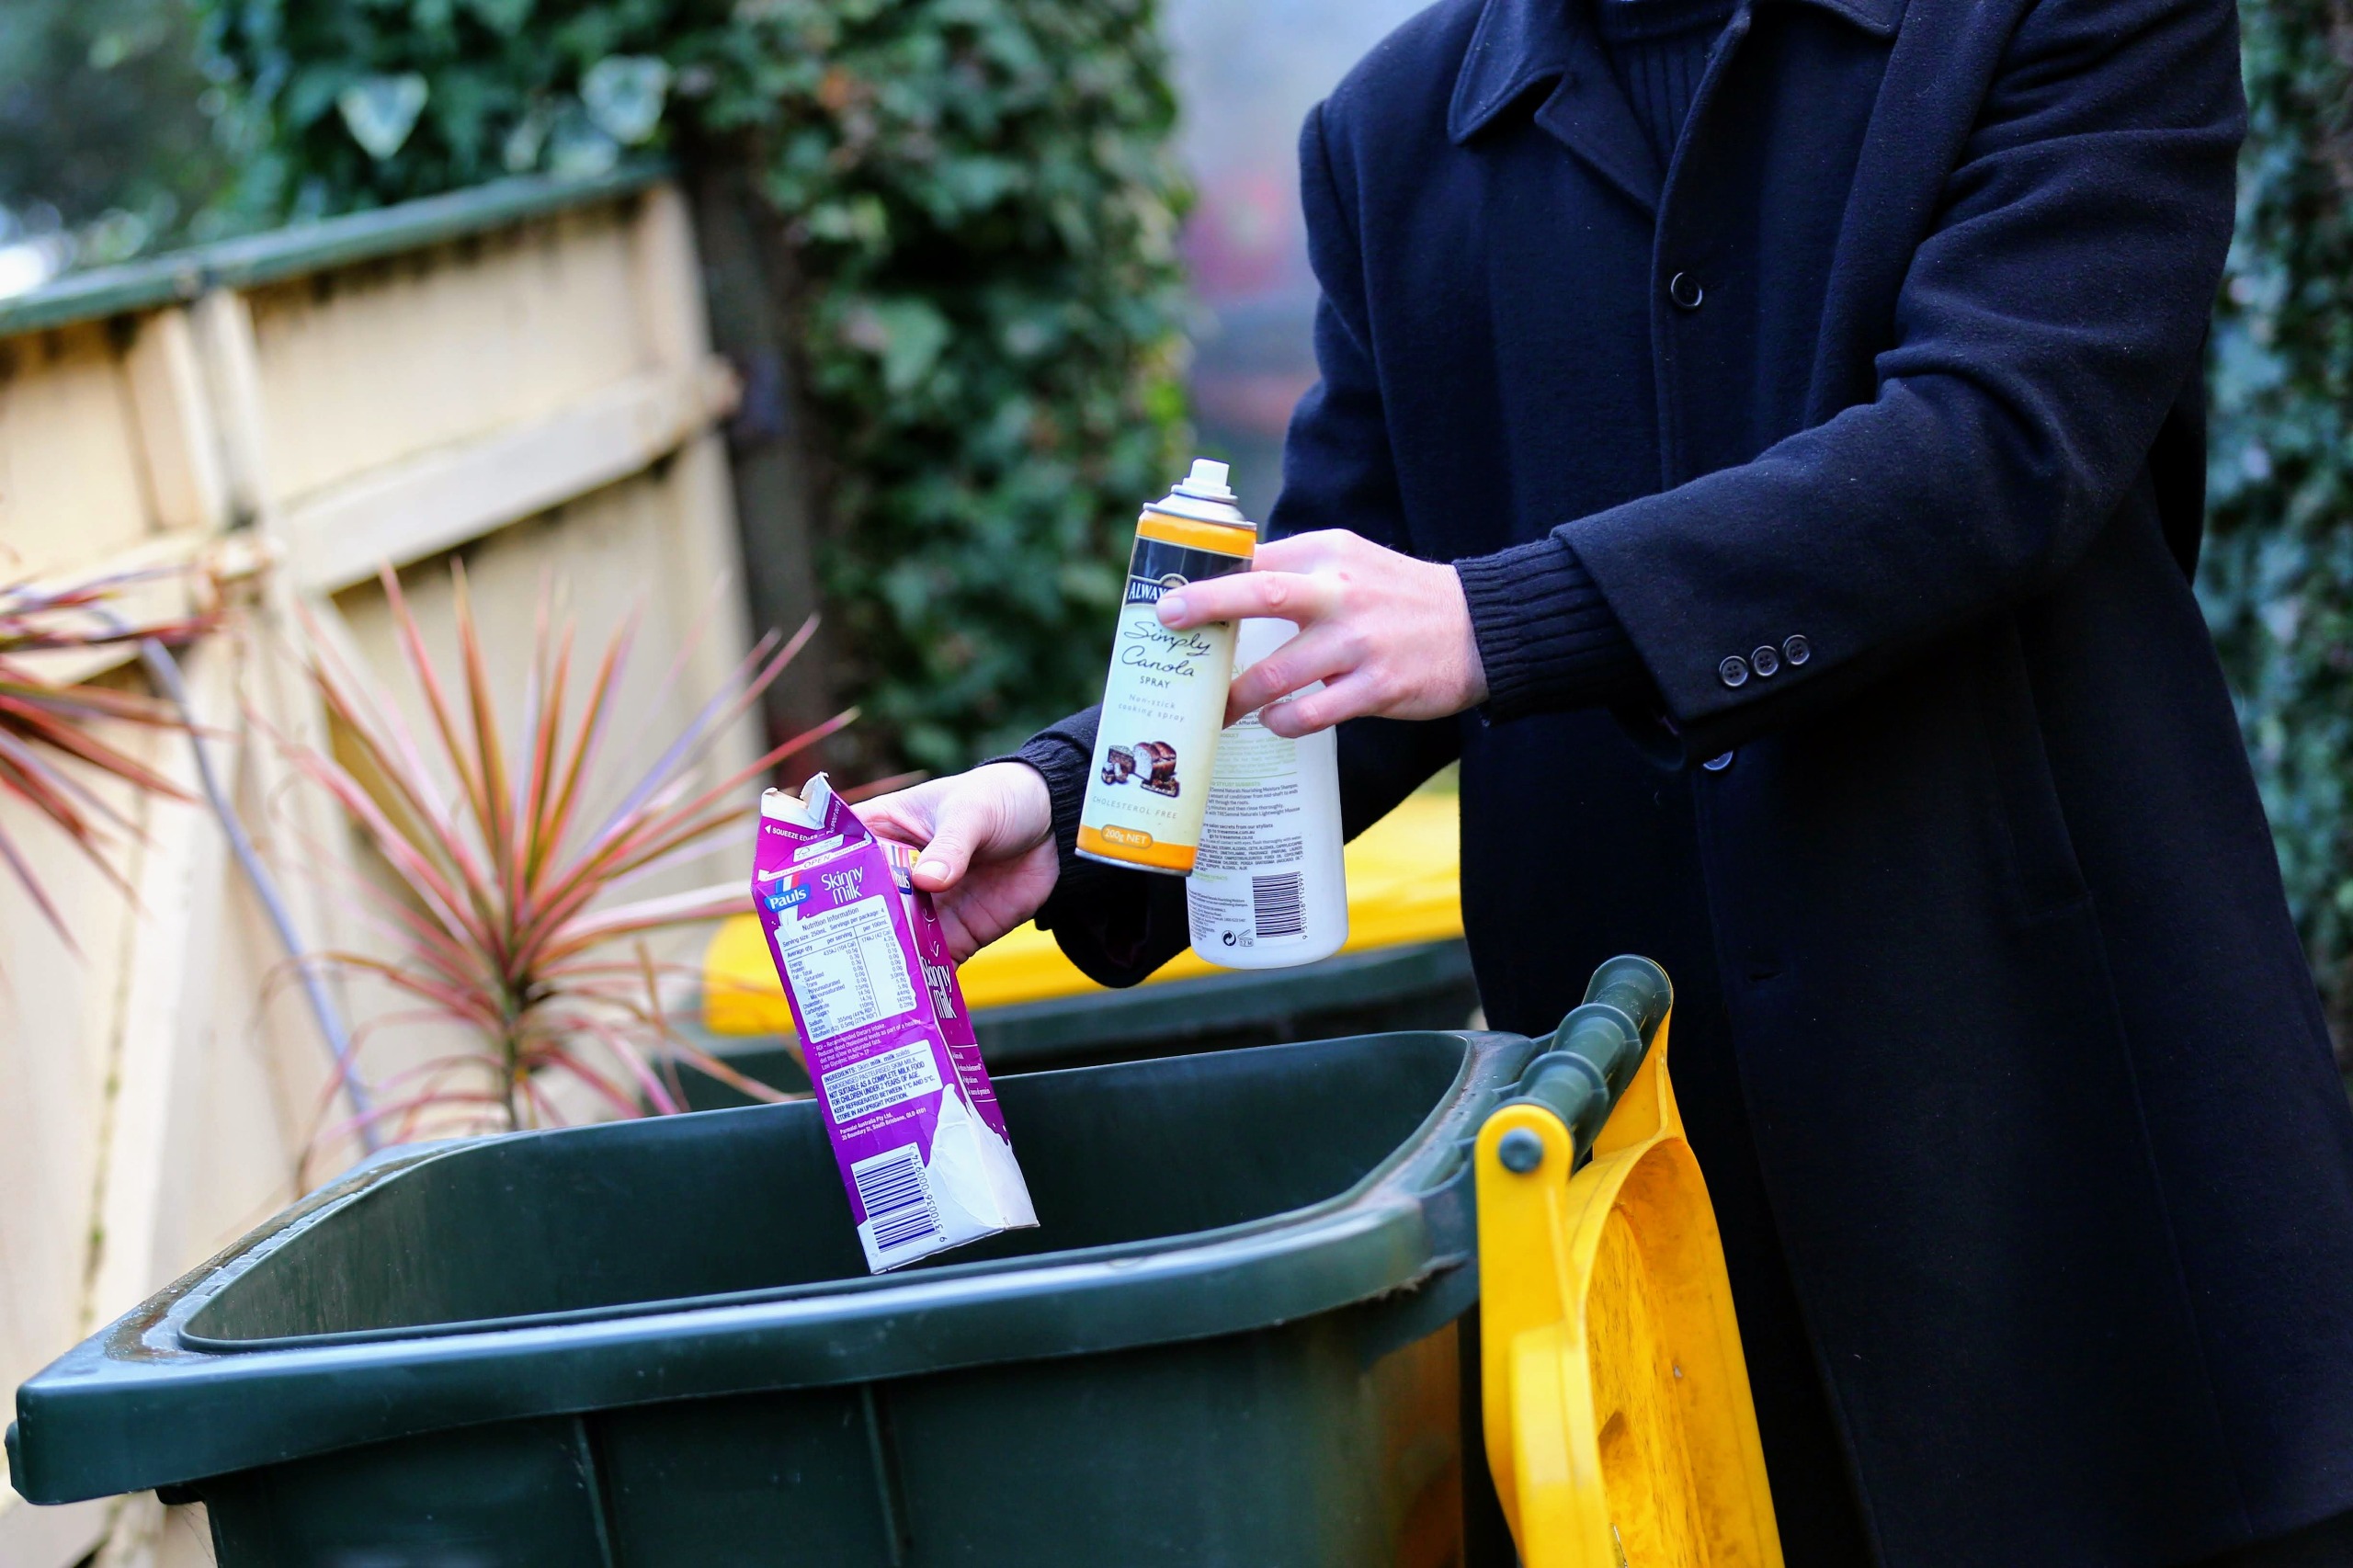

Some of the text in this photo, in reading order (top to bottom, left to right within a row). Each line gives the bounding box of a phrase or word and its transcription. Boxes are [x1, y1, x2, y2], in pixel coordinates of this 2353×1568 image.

[1128, 581, 1168, 600] ALWAY
[1123, 621, 1211, 656] Simply
[1121, 646, 1195, 676] Canola
[1140, 676, 1170, 689] SPRAY
[1129, 694, 1176, 710] Non-stick
[1157, 710, 1185, 722] spray
[1093, 795, 1178, 820] CHOLESTEROL FREE
[771, 826, 799, 839] SQUEEZE
[1105, 829, 1148, 845] 200g NET
[802, 853, 831, 868] OPEN
[821, 866, 863, 891] Skinny
[769, 889, 807, 910] Pauls
[801, 908, 858, 930] Nutrition Information
[782, 938, 799, 947] Serving
[830, 920, 849, 930] Servings
[787, 949, 803, 957] Average
[835, 931, 852, 940] serving
[804, 971, 824, 982] Saturated
[840, 1020, 854, 1028] 0.5mg
[817, 1049, 834, 1057] Reduces
[846, 1036, 868, 1047] cholesterol
[886, 1026, 895, 1034] part
[826, 1028, 870, 1046] Recommended Dietary
[852, 1041, 871, 1052] saturated
[824, 1067, 854, 1082] INGREDIENTS:
[827, 1076, 858, 1091] HOMOGENISED
[859, 1065, 890, 1079] PASTEURISED
[891, 1061, 903, 1069] SKIM
[838, 1084, 858, 1096] SUITABLE
[871, 1070, 896, 1084] COMPLETE
[897, 1066, 909, 1074] MILK
[911, 1062, 925, 1070] FOOD
[840, 1090, 863, 1103] CHILDREN
[863, 1085, 880, 1095] UNDER
[884, 1077, 900, 1086] YEARS
[908, 1071, 918, 1079] AGE.
[846, 1094, 878, 1108] REFRIGERATED
[880, 1086, 902, 1097] BETWEEN
[836, 1112, 850, 1120] STORE
[864, 1100, 883, 1111] UPRIGHT
[884, 1093, 907, 1103] POSITION.
[847, 1129, 866, 1138] Boundary
[858, 1119, 876, 1127] Australia
[925, 1194, 943, 1230] 310036
